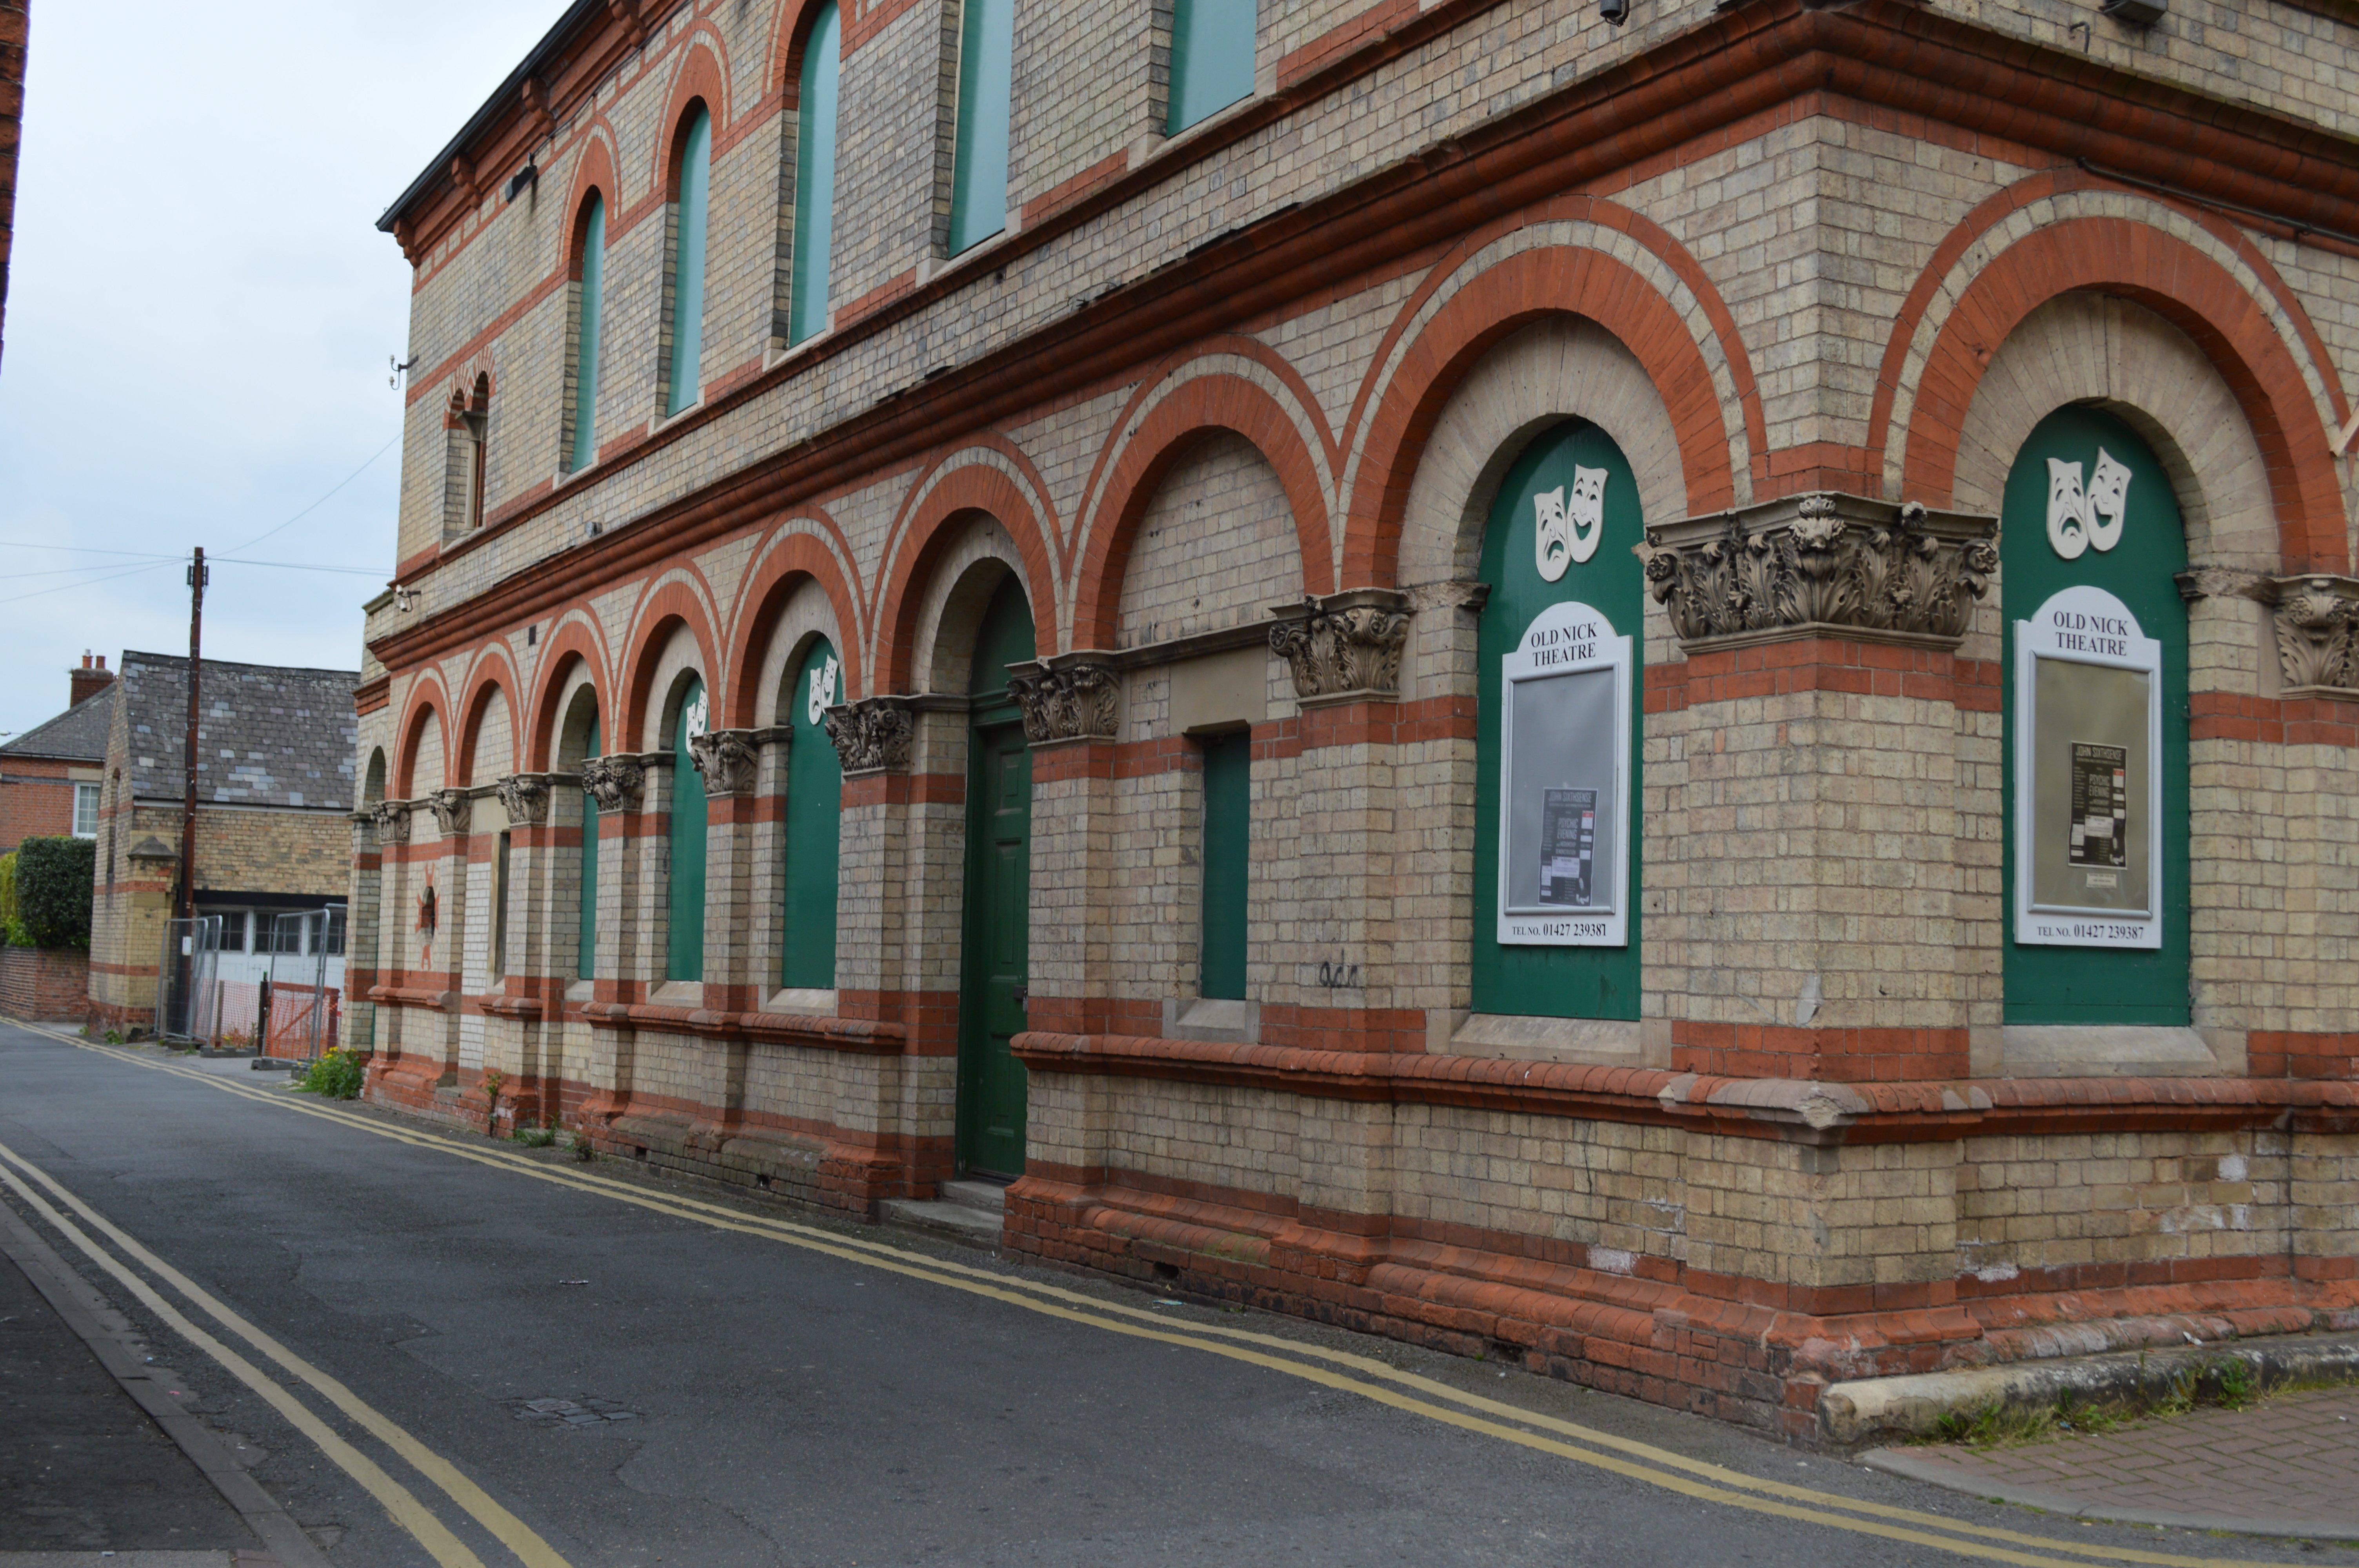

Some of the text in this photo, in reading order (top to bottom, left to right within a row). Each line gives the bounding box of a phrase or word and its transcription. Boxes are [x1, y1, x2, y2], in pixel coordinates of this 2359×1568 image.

[2054, 611, 2128, 636] OLD NICK
[1531, 622, 1597, 648] OLD NICK
[2055, 632, 2127, 656] THEATRE
[1532, 642, 1596, 666] THEATRE
[2076, 746, 2122, 760] JOHN SIXTHSENSE
[2089, 774, 2110, 786] PSYCHIC
[1562, 791, 1592, 803] SIXTHSENSE
[2089, 785, 2109, 798] EVENING
[1558, 817, 1578, 829] PSYCHIC
[1557, 828, 1577, 840] EVENING
[1512, 926, 1526, 935] TEL
[1527, 927, 1540, 936] NO.
[1543, 923, 1570, 936] 01427
[2037, 924, 2144, 940] TEL NO. 01427 239387
